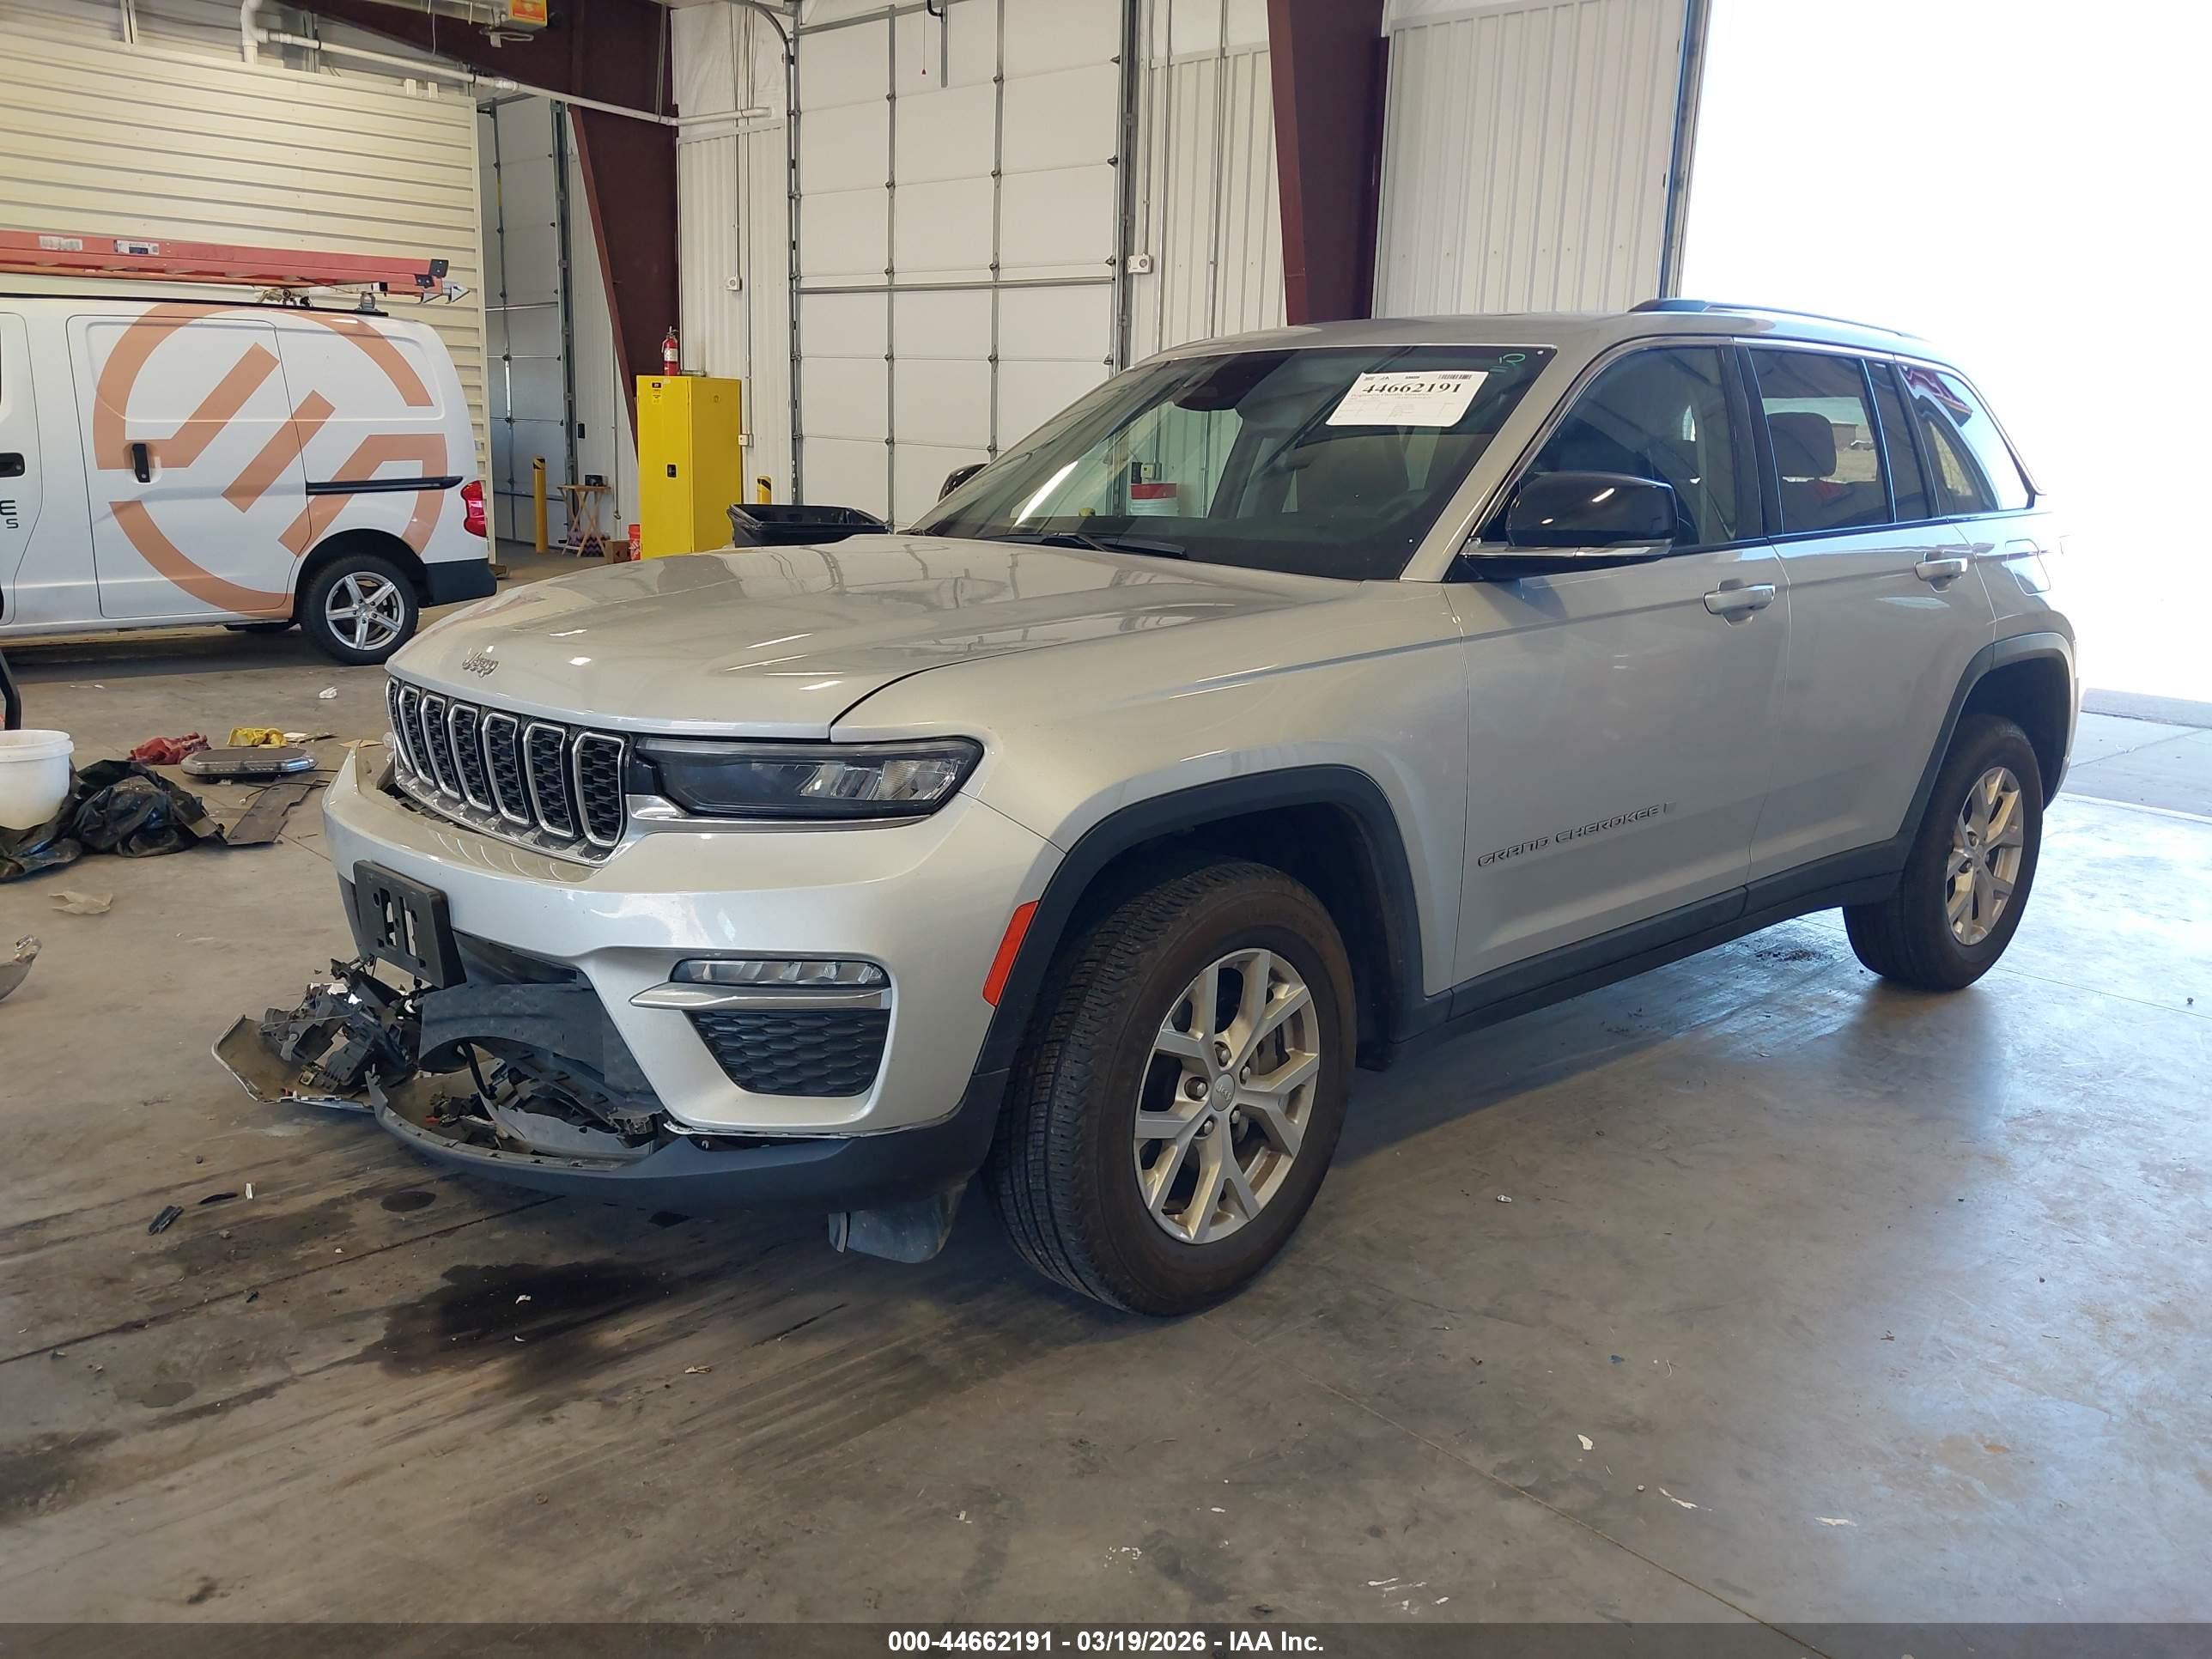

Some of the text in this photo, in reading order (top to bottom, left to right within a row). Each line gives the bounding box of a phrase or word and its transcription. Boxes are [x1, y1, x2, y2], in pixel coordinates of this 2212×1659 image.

[1362, 383, 1462, 394] 44662191
[461, 652, 499, 678] Jeep
[1477, 804, 1660, 867] GRAND CHEROKEE
